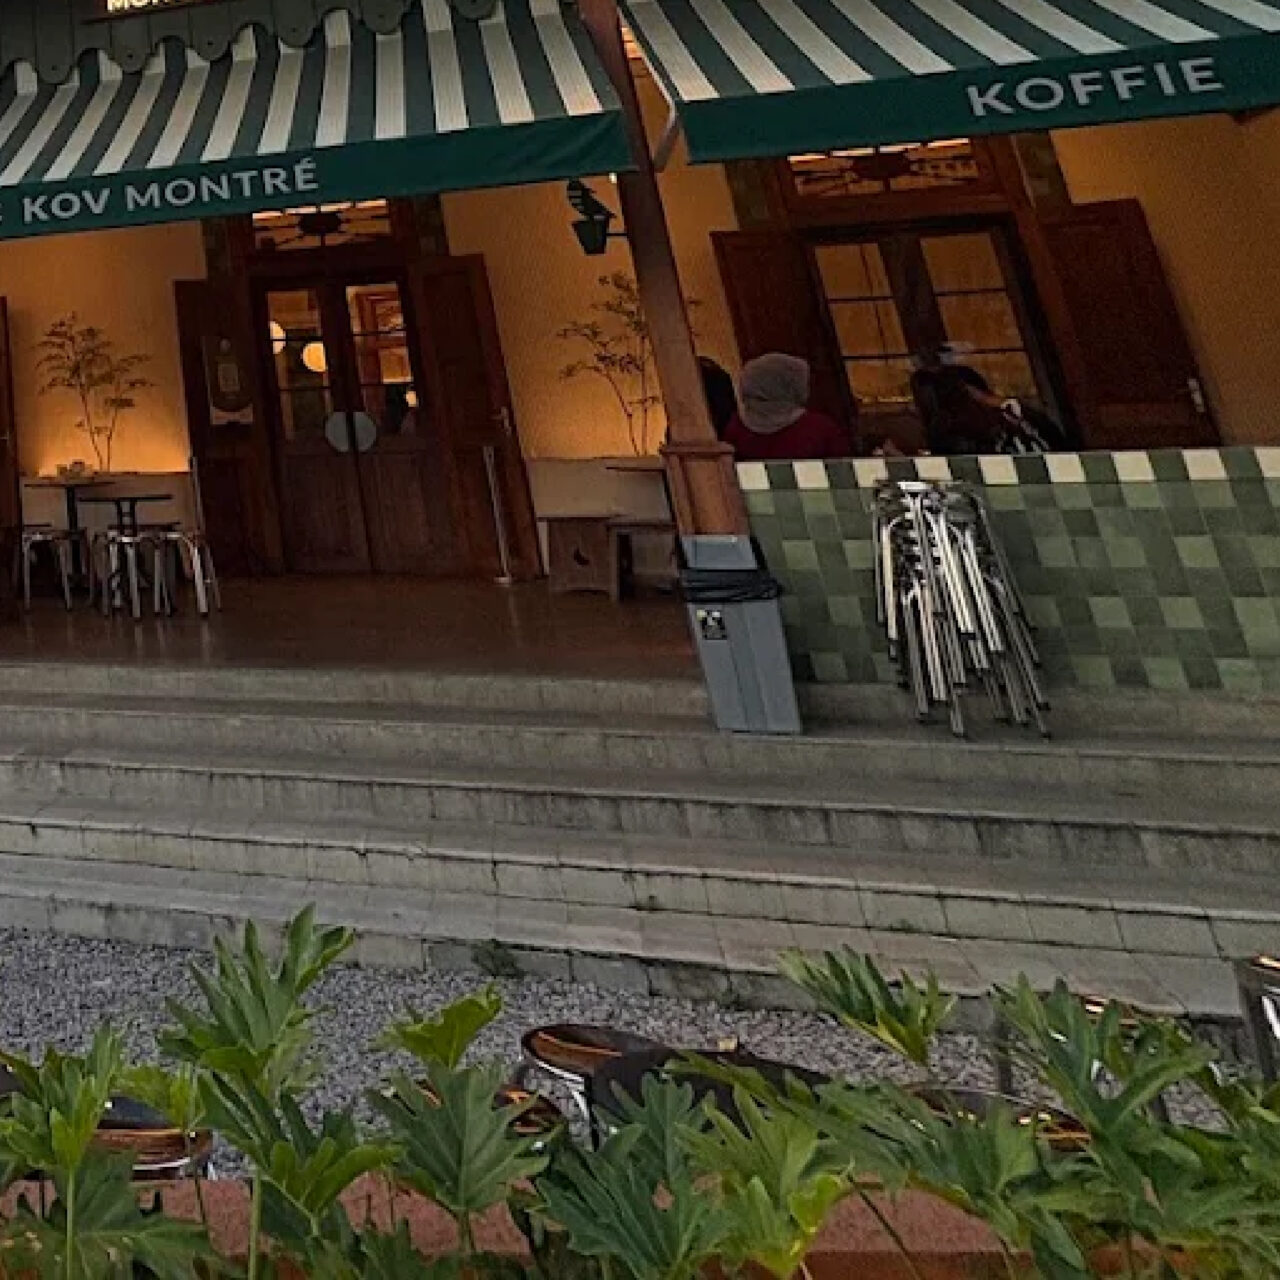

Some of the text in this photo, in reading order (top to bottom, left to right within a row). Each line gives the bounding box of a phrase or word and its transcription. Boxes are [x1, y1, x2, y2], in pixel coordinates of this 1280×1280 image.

[966, 57, 1224, 116] KOFFIE
[22, 157, 319, 224] KOV MONTRÉ
